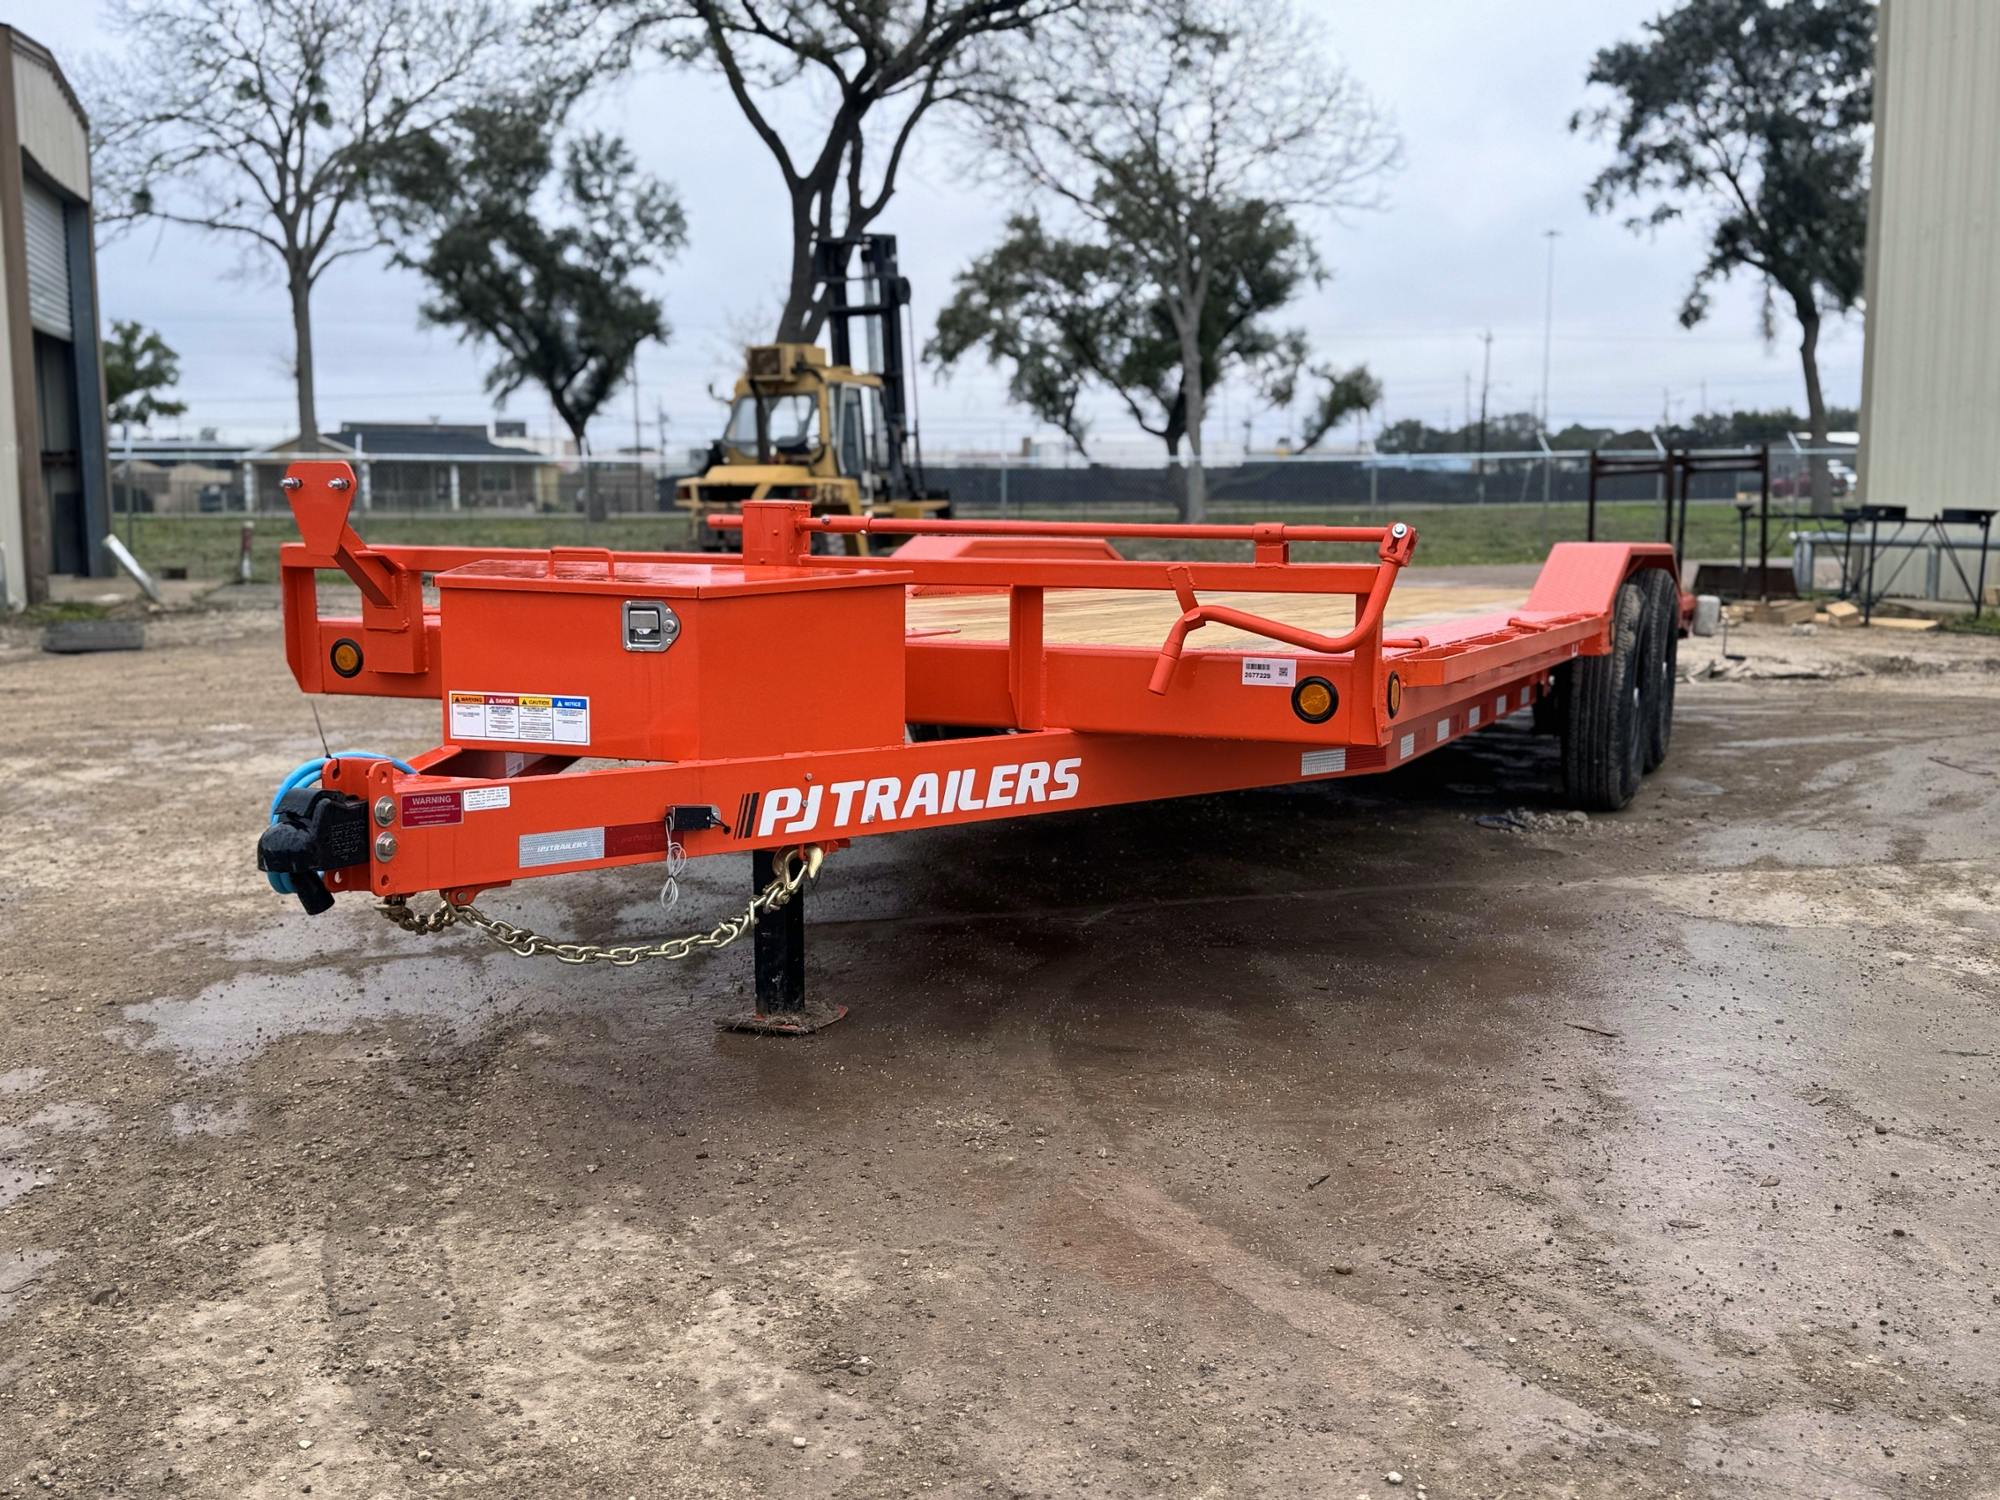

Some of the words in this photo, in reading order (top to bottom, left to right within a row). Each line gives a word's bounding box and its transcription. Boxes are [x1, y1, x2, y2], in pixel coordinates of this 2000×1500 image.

[412, 795, 452, 805] WARNING
[757, 784, 824, 838] PJ
[829, 757, 1082, 828] TRAILERS
